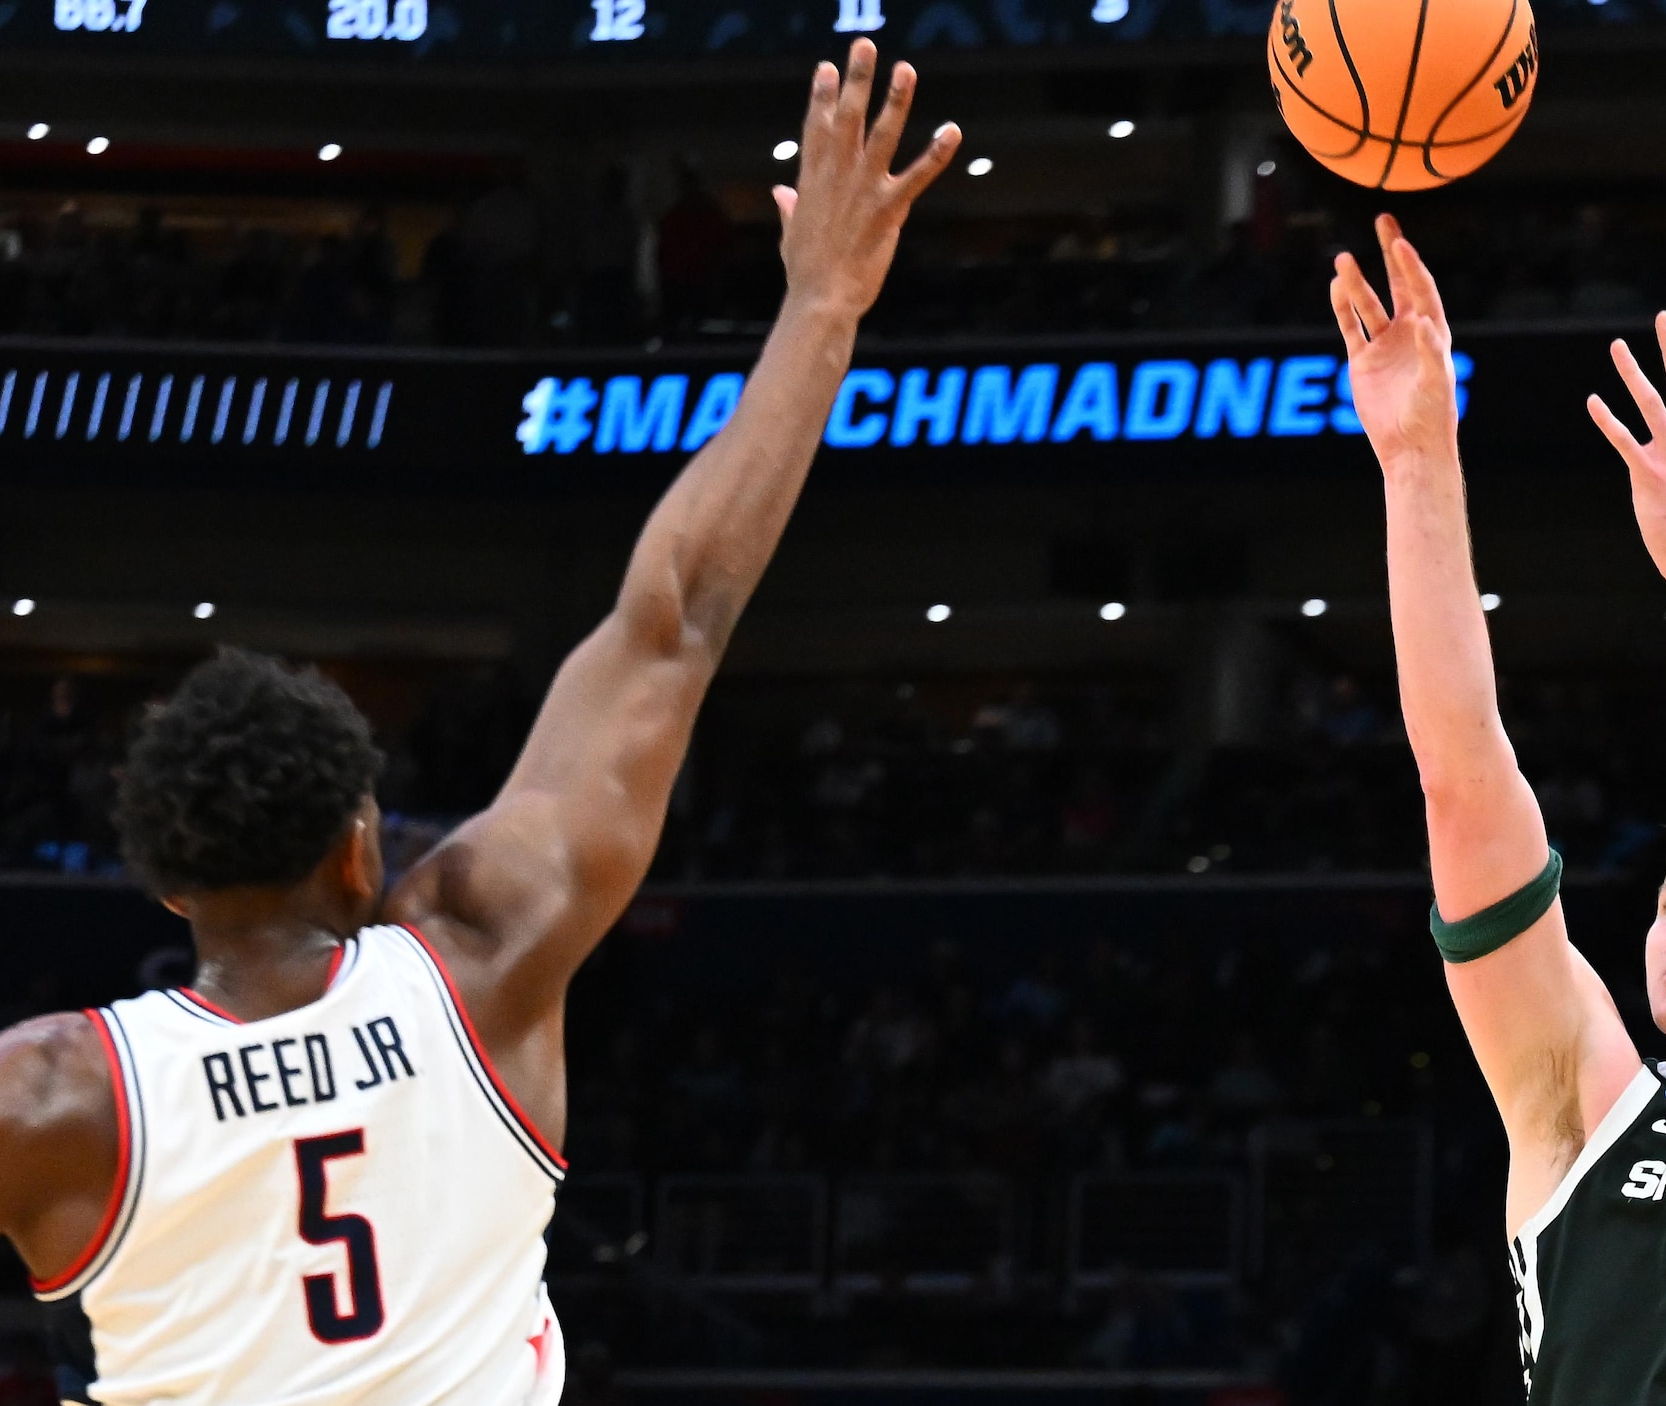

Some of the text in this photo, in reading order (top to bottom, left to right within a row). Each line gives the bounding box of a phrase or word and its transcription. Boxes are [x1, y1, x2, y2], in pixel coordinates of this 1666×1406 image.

[515, 350, 1474, 455] #MACHMADNE
[202, 1015, 416, 1122] REED JR
[293, 1127, 385, 1345] 5
